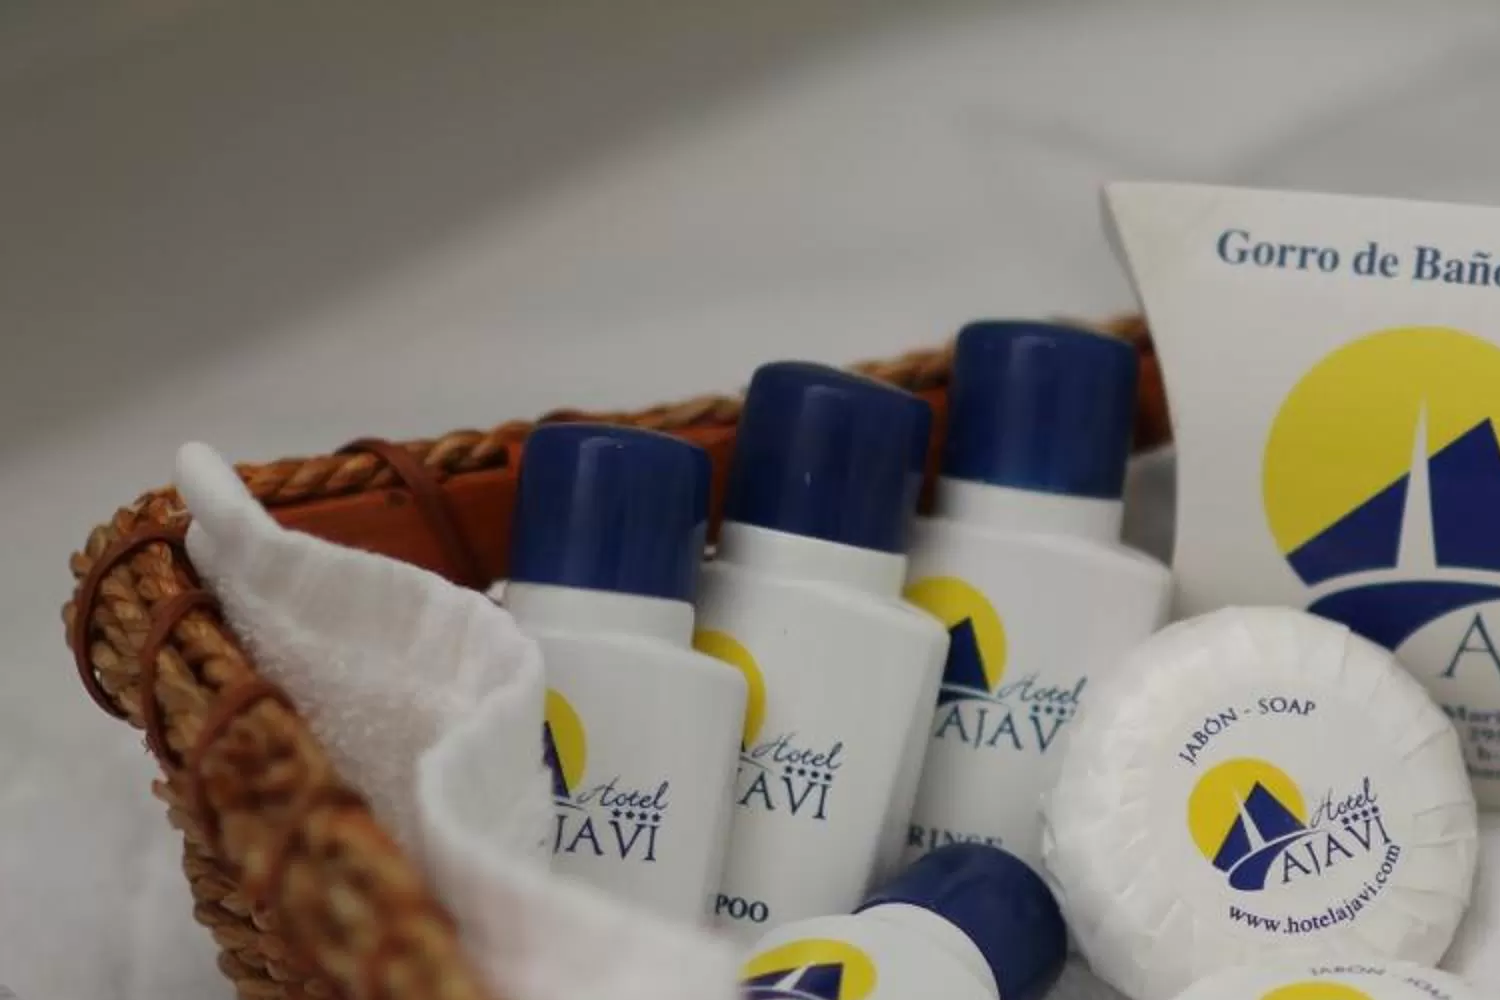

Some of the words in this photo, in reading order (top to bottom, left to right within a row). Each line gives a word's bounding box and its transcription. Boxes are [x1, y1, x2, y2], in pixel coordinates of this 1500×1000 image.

[1216, 228, 1340, 274] Gorro
[1352, 241, 1399, 279] de
[933, 704, 1071, 754] AJAV
[1258, 696, 1317, 716] SOAP
[752, 731, 843, 770] Hotel
[576, 775, 669, 811] Hotel
[737, 770, 832, 820] AVI
[1310, 775, 1378, 828] Hotel
[554, 814, 661, 861] JAVI
[1281, 815, 1393, 885] AJAVI
[714, 893, 769, 923] POO
[1228, 844, 1401, 935] www.hotelajavi.com
